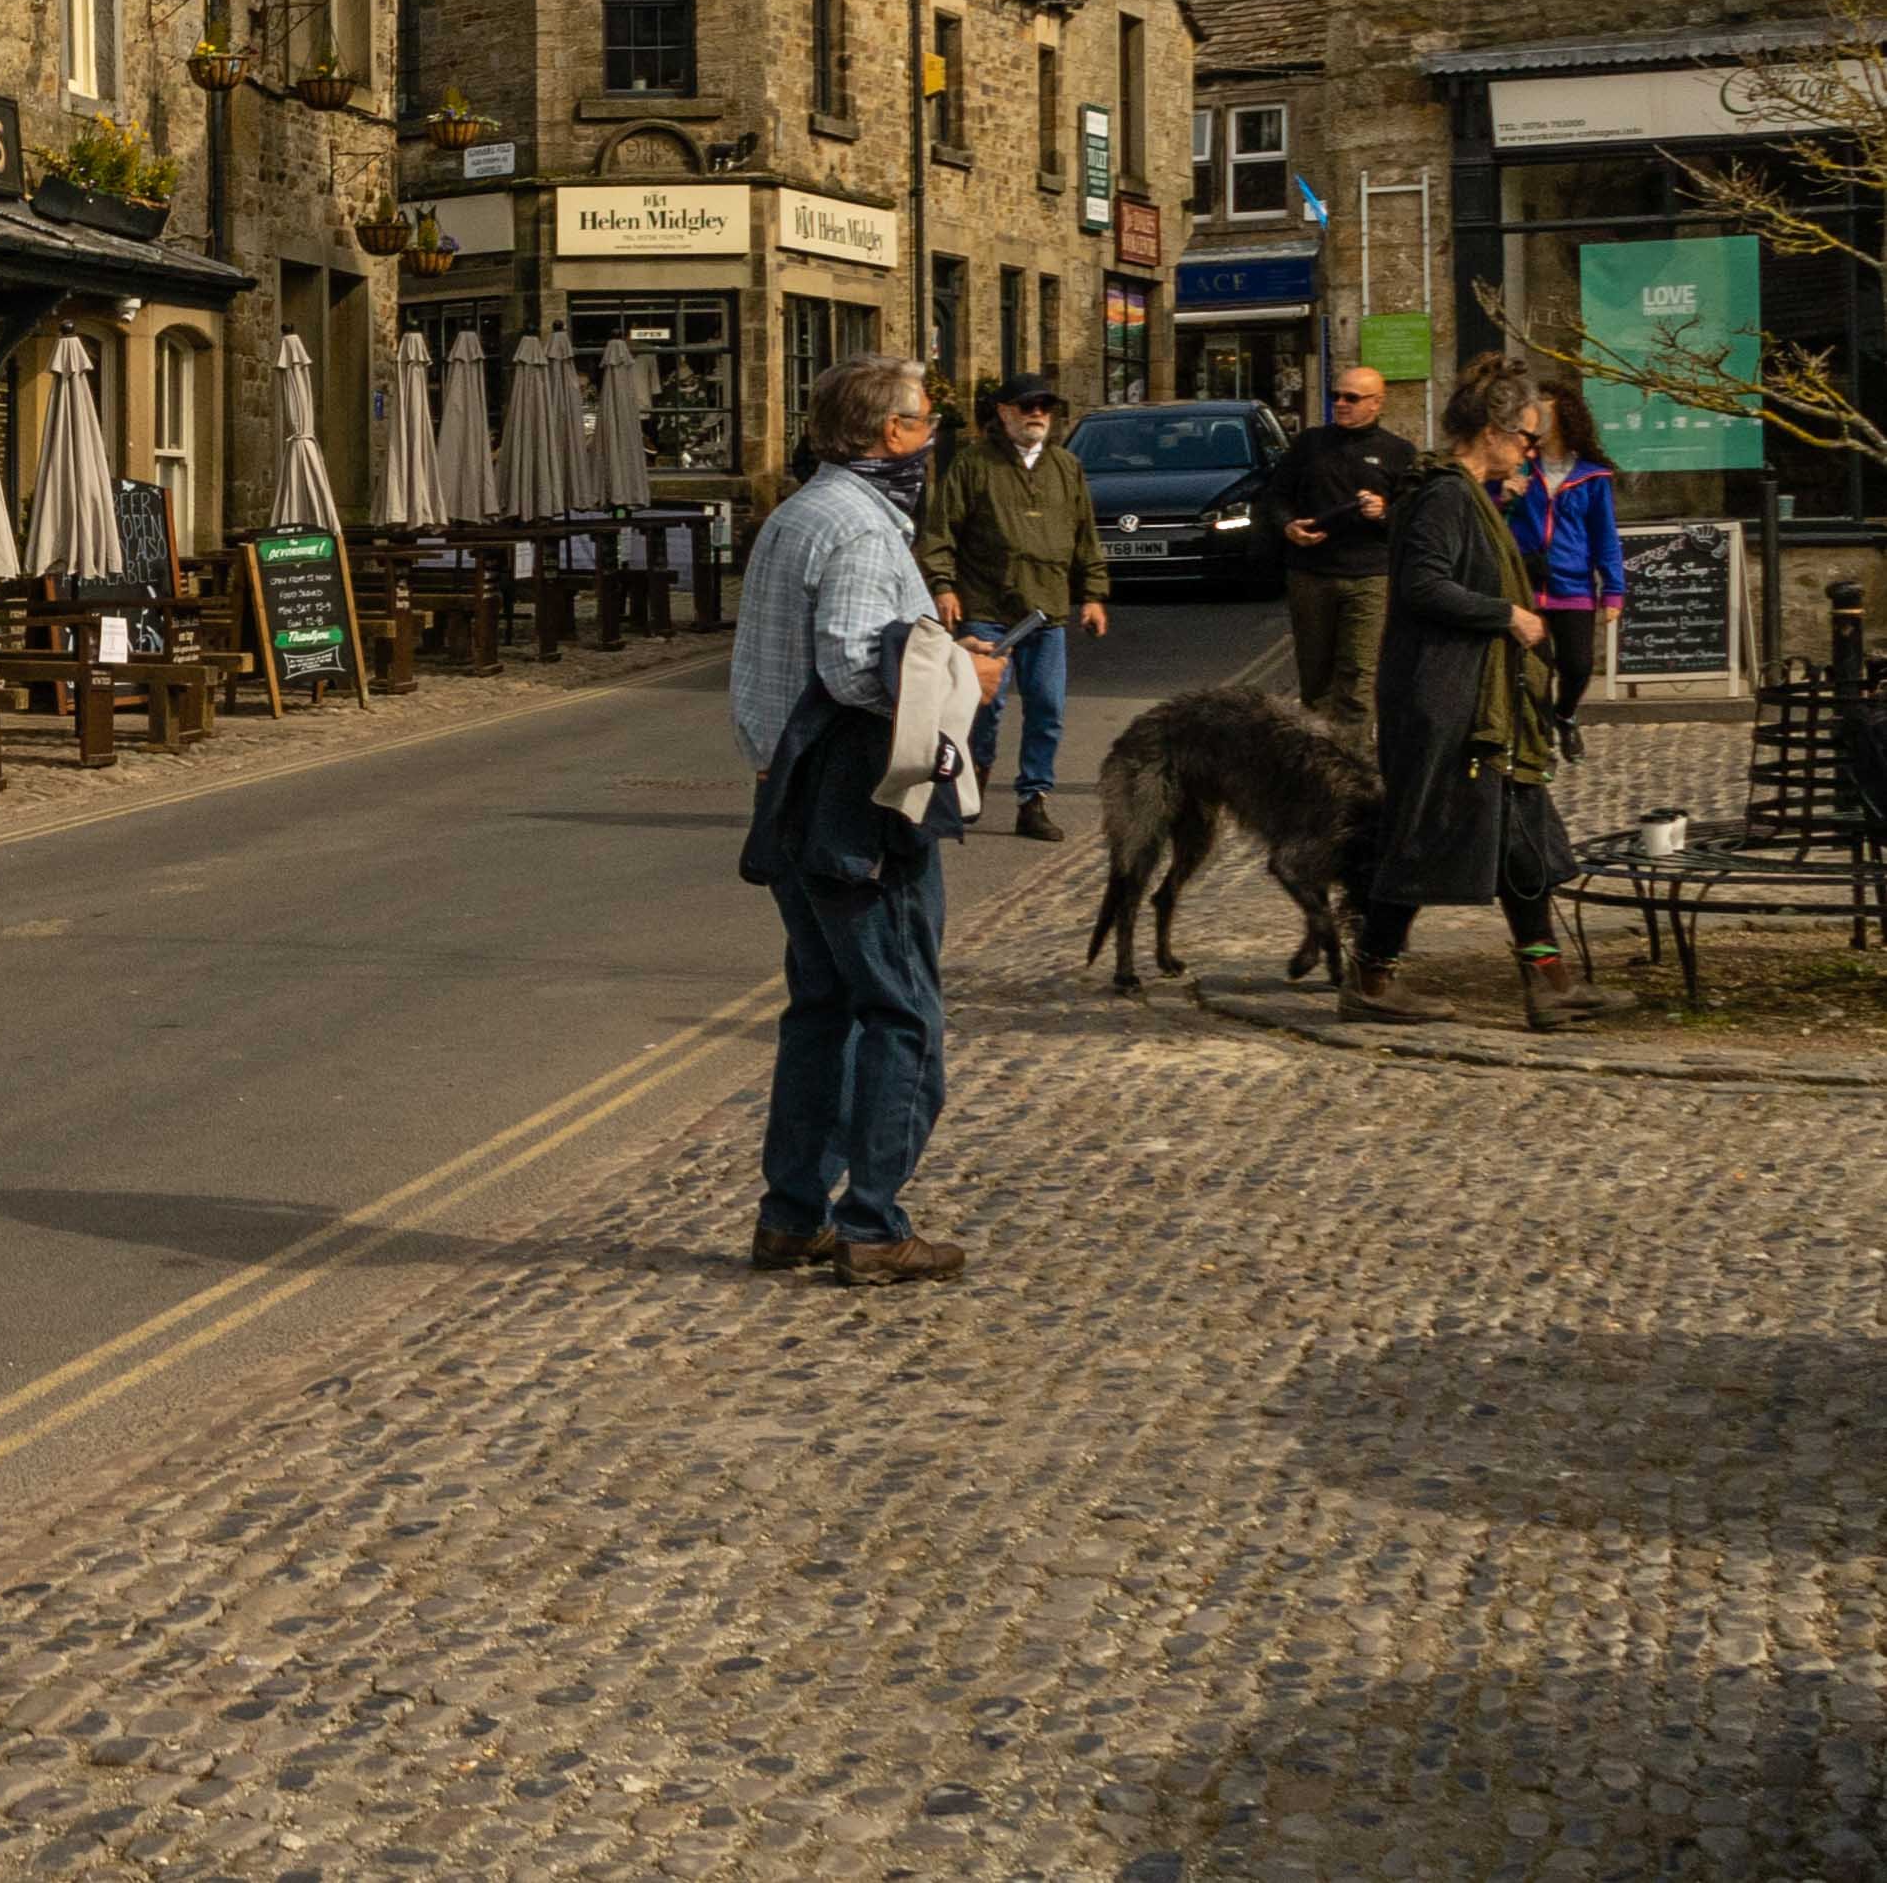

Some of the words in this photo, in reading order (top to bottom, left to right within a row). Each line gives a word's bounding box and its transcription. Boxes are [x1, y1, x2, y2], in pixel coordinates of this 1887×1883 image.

[579, 210, 640, 230] Helen
[646, 208, 728, 235] Midgley
[818, 212, 846, 245] Helen
[847, 218, 882, 260] Midgley
[1643, 285, 1696, 305] LOVE
[122, 515, 164, 543] OPEN
[136, 536, 167, 560] ALSO
[1102, 543, 1132, 555] Y68
